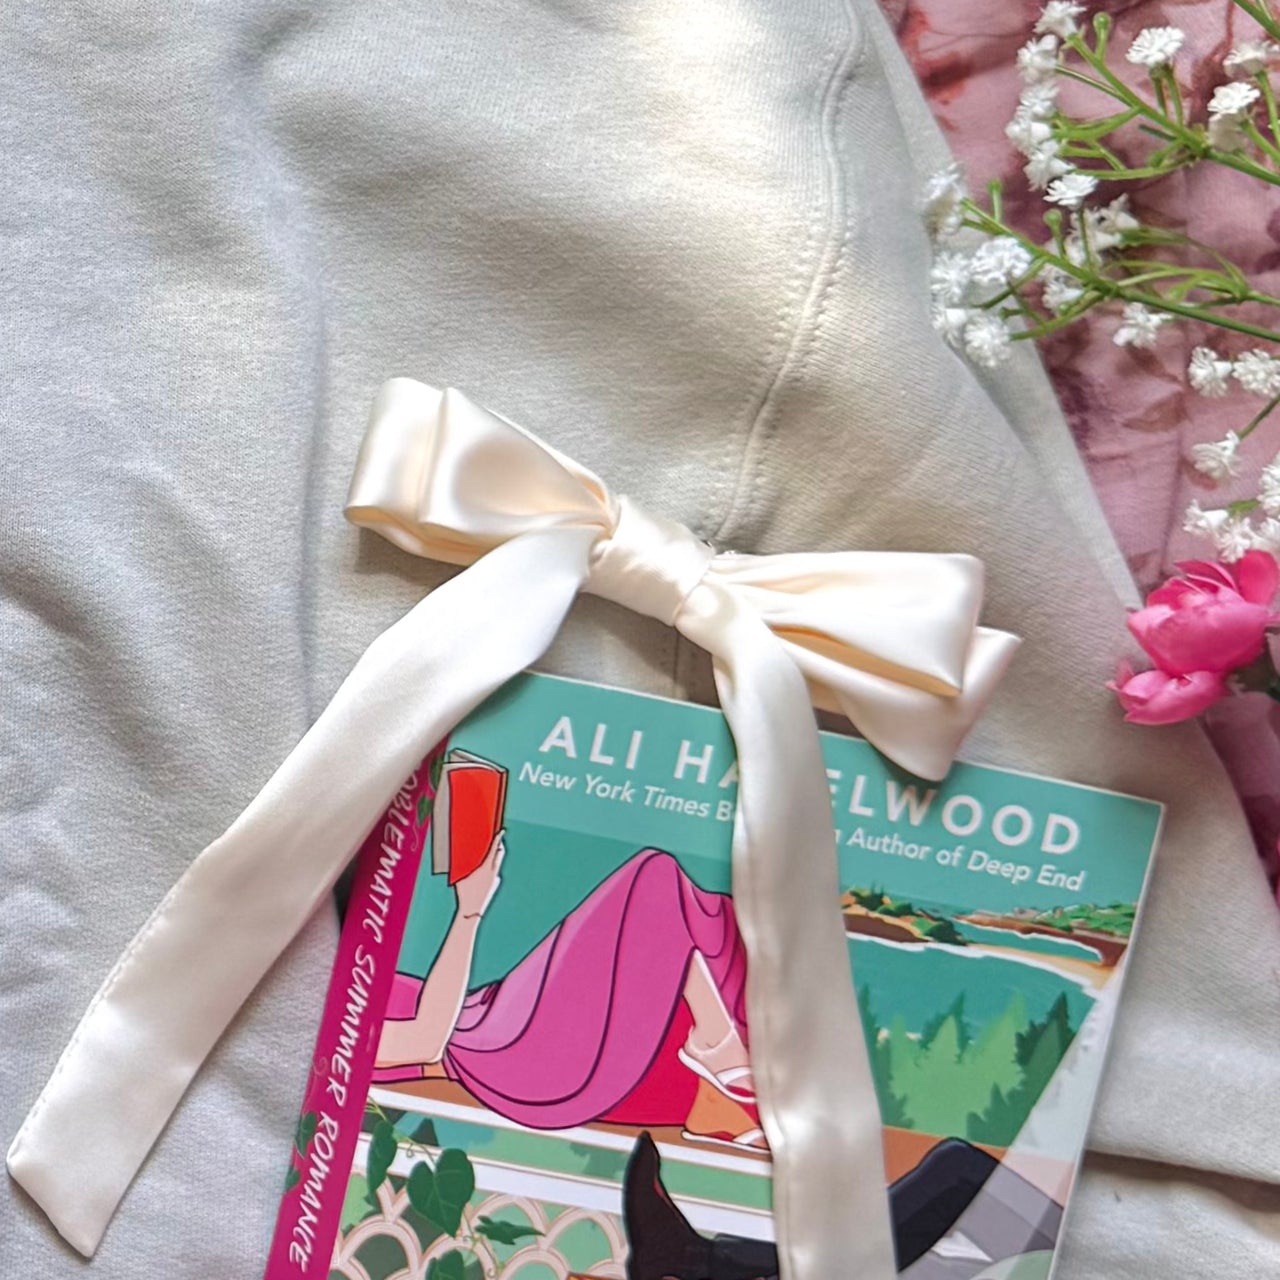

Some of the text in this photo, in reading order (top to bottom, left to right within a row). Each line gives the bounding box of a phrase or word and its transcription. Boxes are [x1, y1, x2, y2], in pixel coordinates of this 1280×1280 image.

[518, 761, 711, 818] New York Times
[539, 716, 643, 770] ALI
[673, 740, 1080, 855] HLWOOD
[846, 826, 1086, 892] Author of Deep End
[326, 944, 376, 1108] SUMMER
[289, 1110, 339, 1273] ROMANCE
